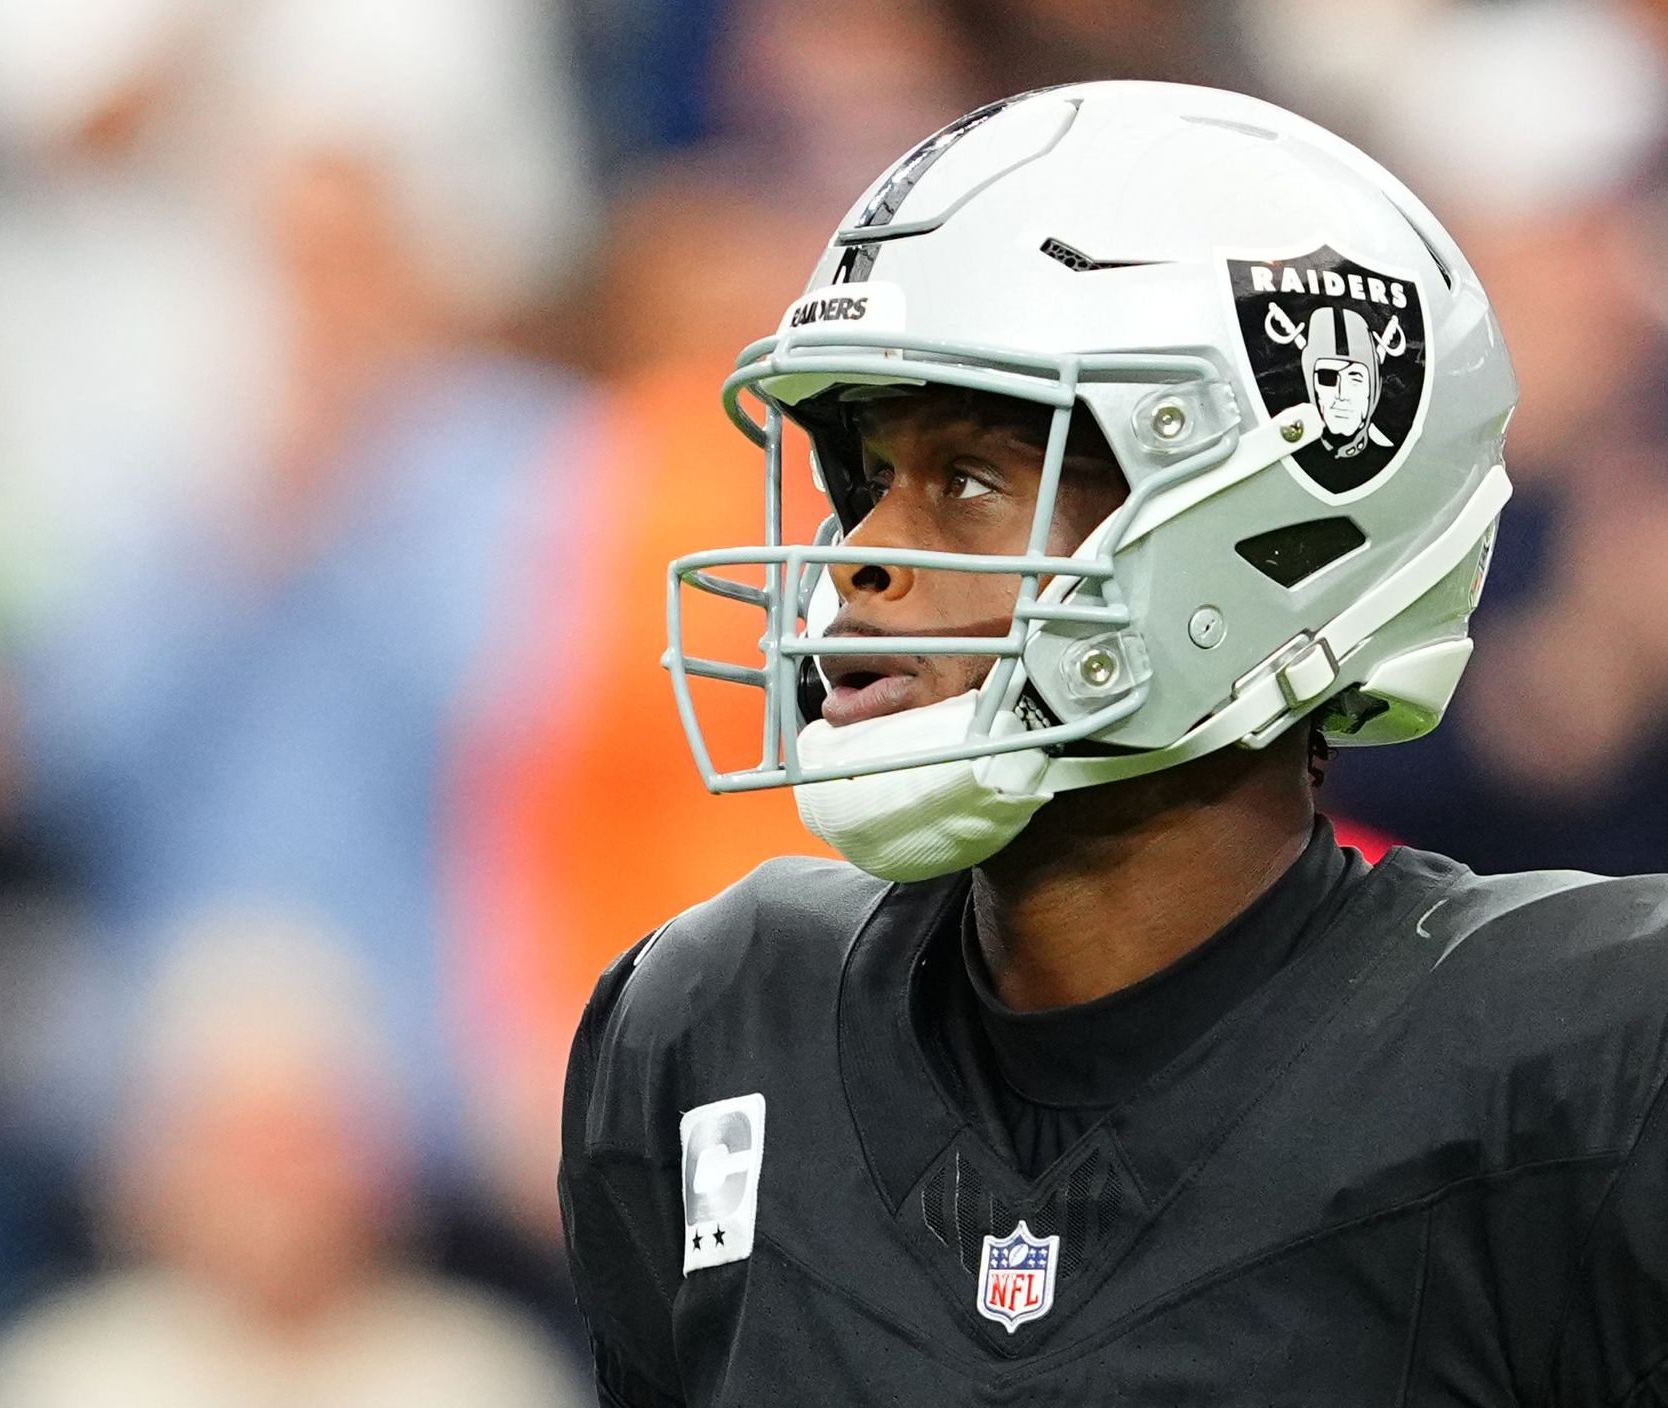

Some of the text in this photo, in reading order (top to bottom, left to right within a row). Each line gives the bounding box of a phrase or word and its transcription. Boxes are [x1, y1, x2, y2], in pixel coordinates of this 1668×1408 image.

[1250, 266, 1408, 309] RAIDERS
[685, 1110, 753, 1227] C
[989, 1273, 1039, 1312] NFL
